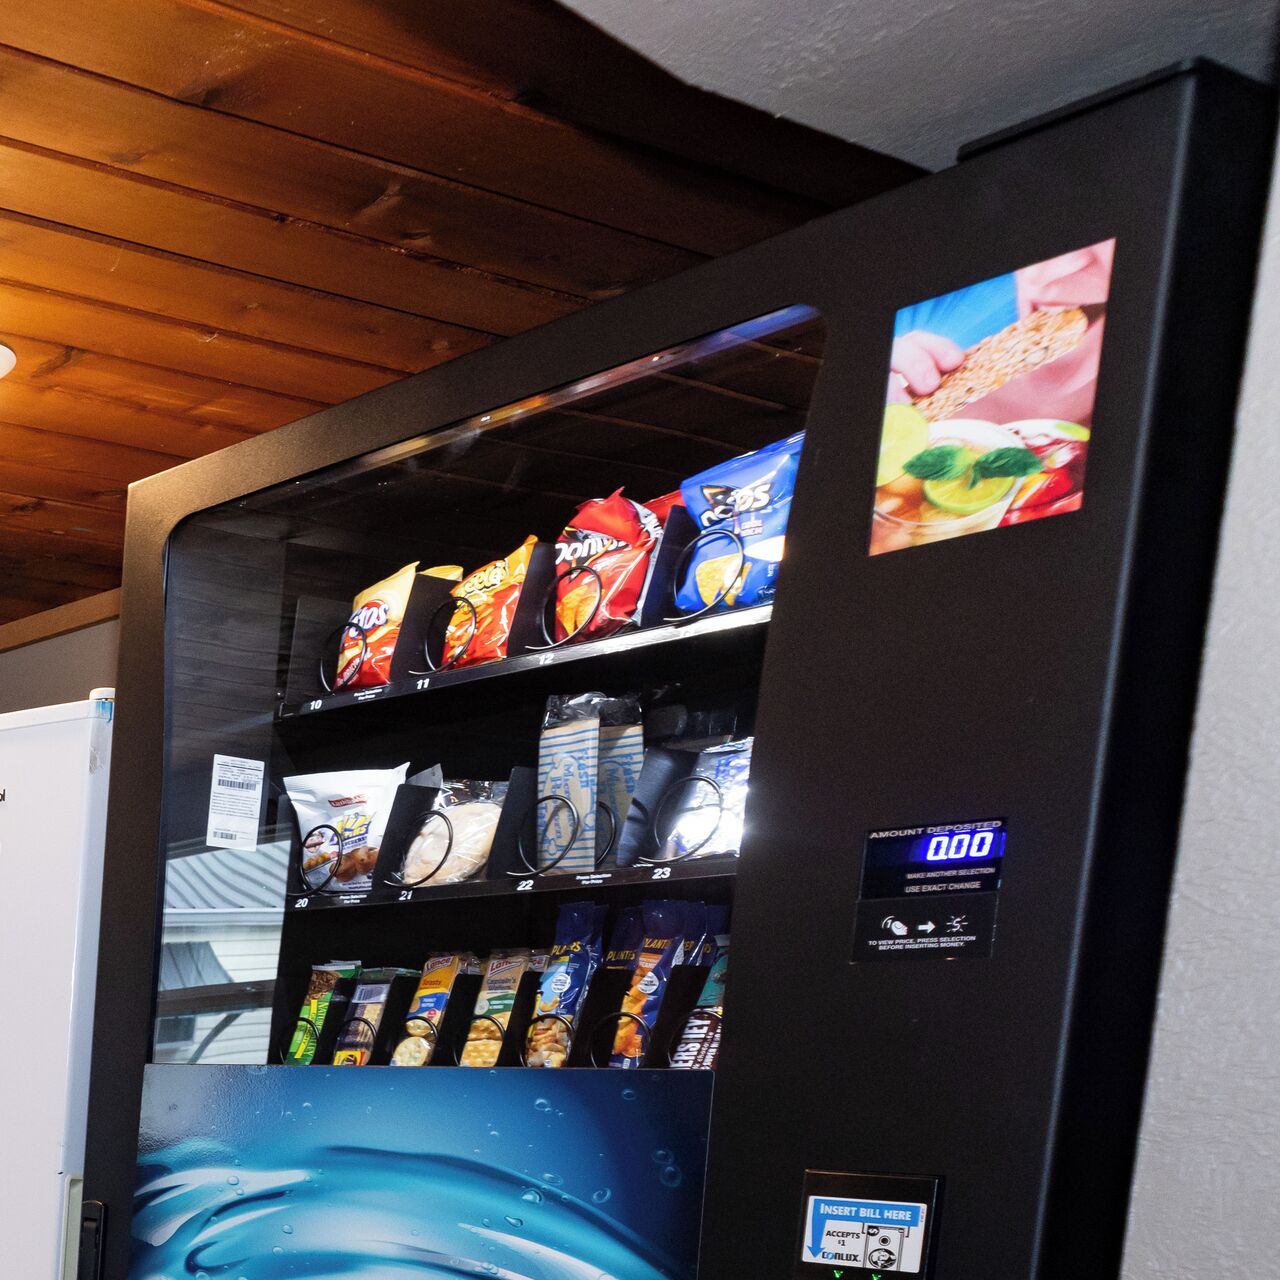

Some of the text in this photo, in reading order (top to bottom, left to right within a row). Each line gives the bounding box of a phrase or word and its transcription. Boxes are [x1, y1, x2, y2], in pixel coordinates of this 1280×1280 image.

[539, 653, 555, 665] 12
[416, 678, 430, 690] 11
[310, 699, 323, 711] 10
[870, 820, 1002, 839] AMOUNT DEPOSITED
[652, 867, 671, 879] 23
[926, 870, 958, 878] ANOTHER
[957, 867, 996, 876] SELECTION
[517, 879, 534, 891] 22
[905, 881, 981, 893] USE EXACT CHANGE
[398, 890, 413, 901] 21
[294, 898, 309, 908] 20
[490, 959, 515, 972] Lan
[820, 1203, 912, 1221] INSERT BILL HERE
[825, 1230, 860, 1239] ACCEPTS
